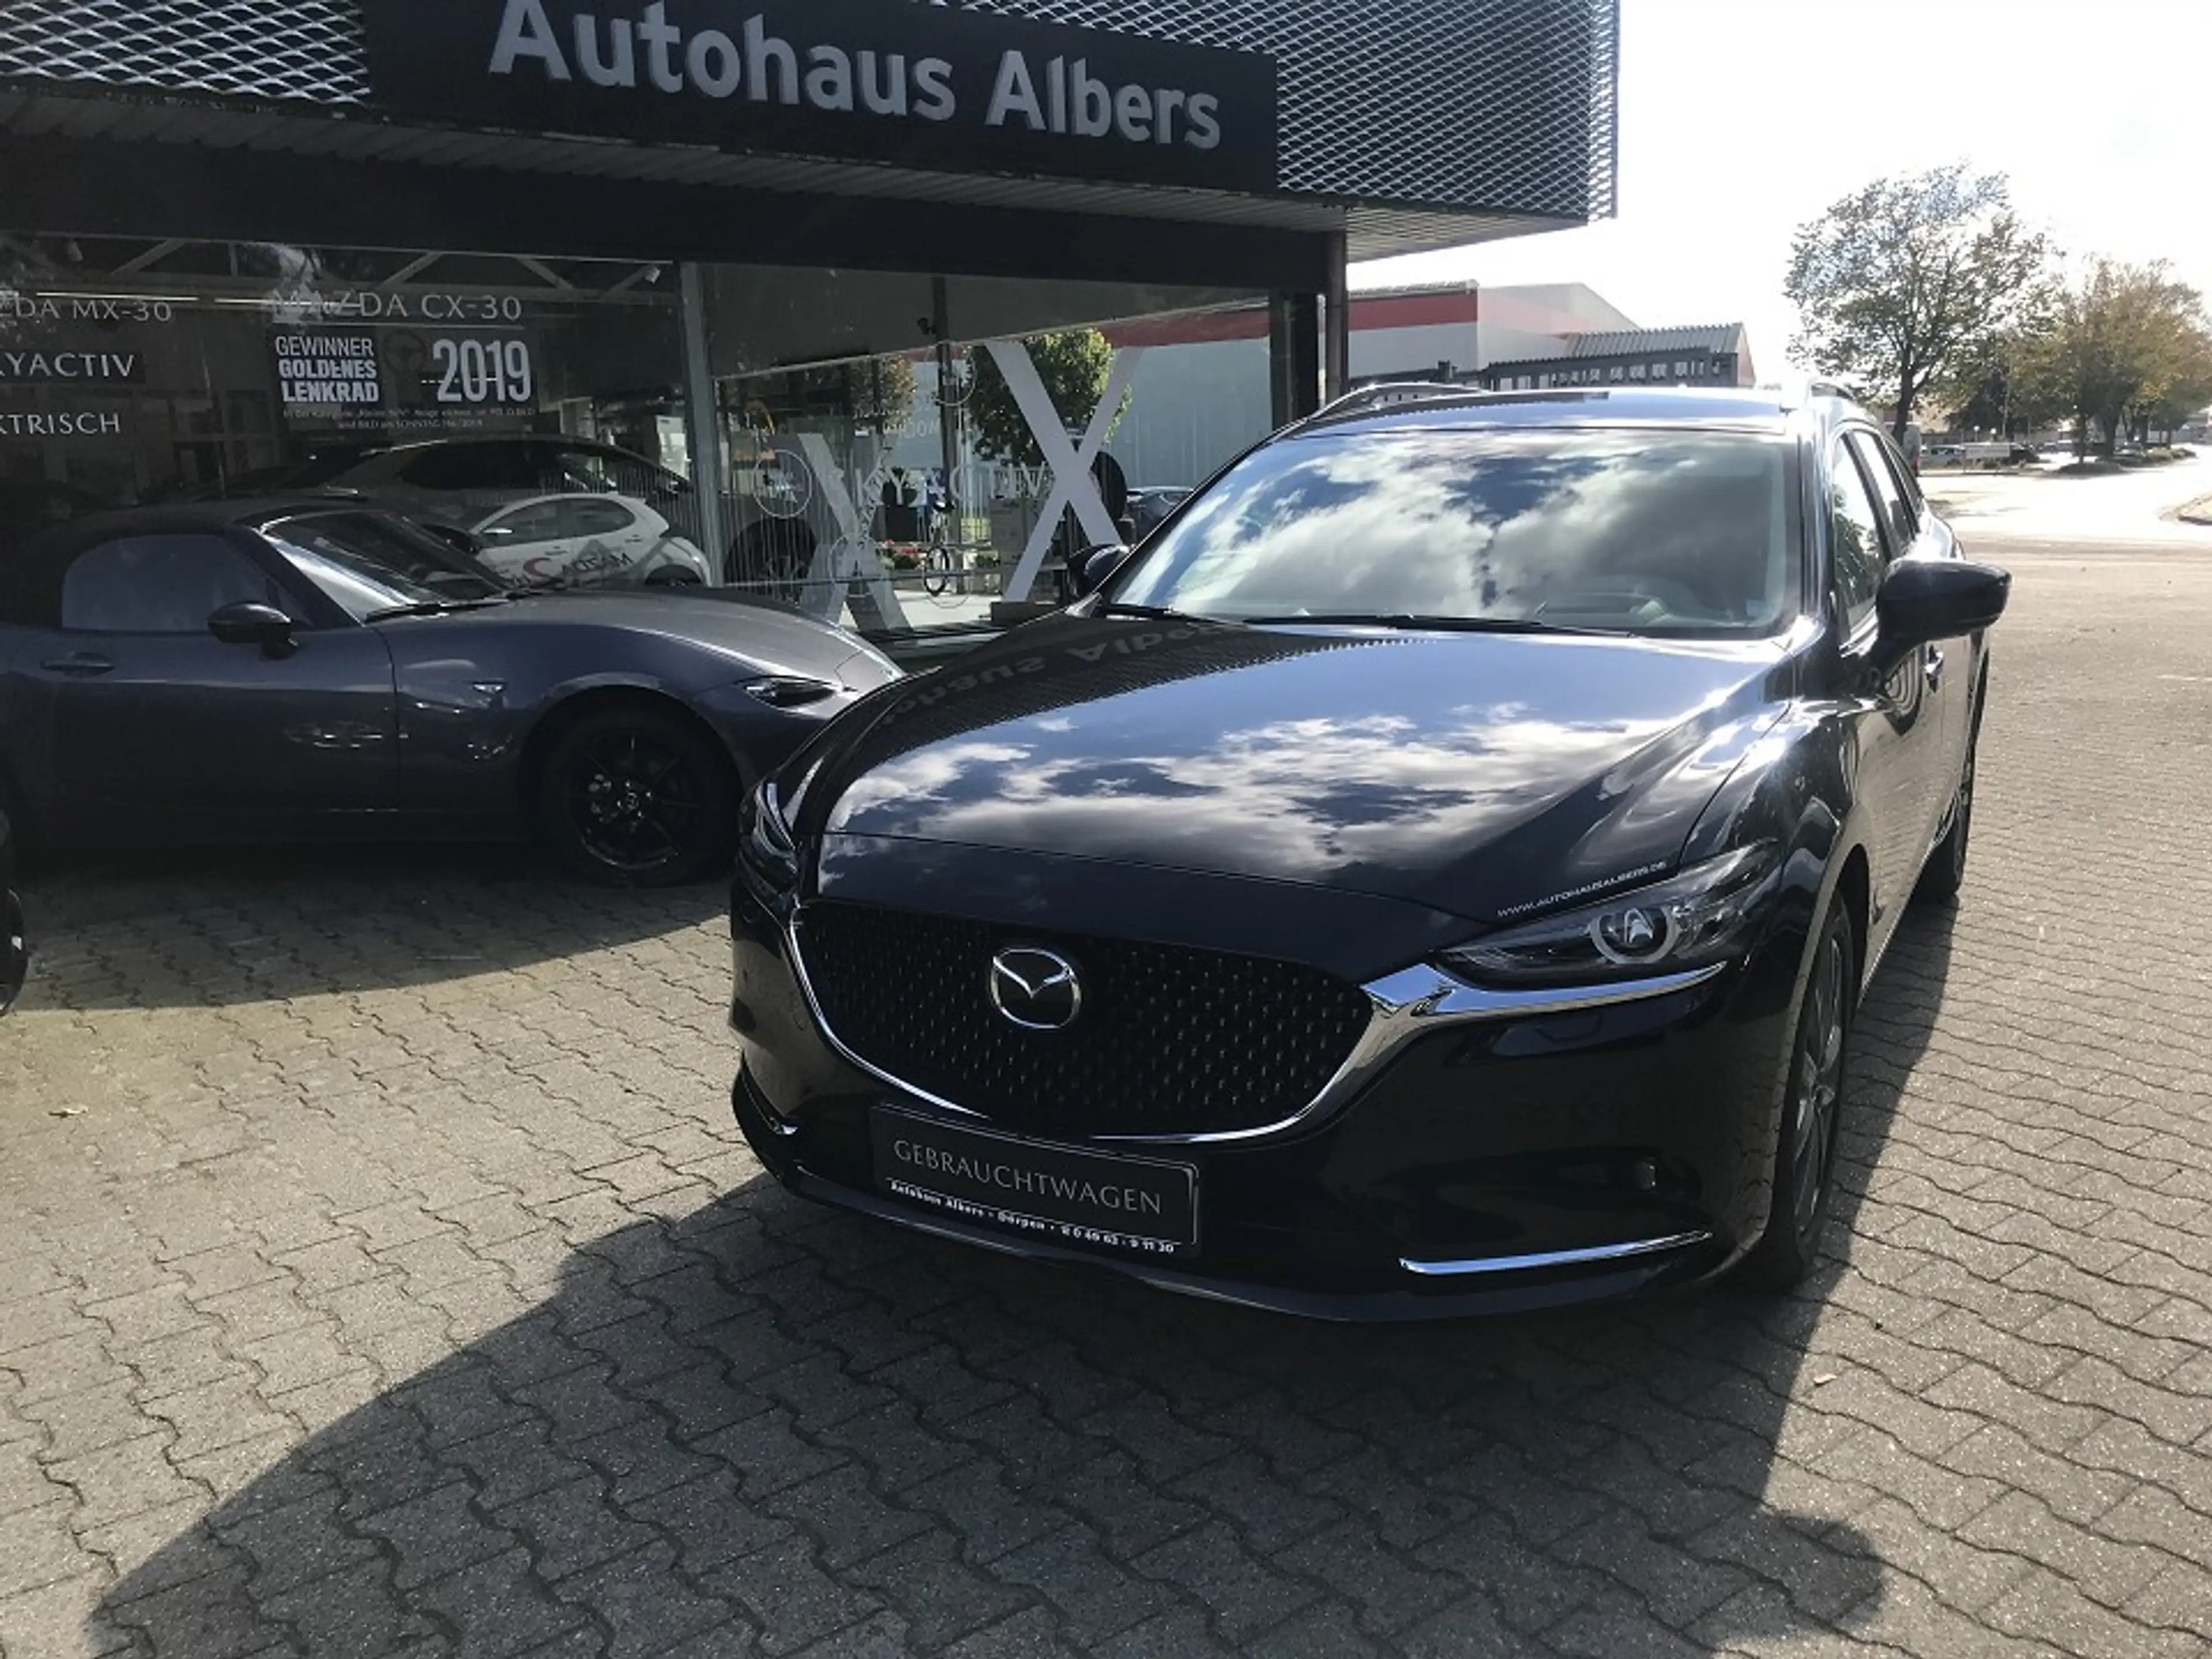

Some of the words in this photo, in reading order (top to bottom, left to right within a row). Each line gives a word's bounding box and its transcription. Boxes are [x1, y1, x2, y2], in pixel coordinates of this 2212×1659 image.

[488, 0, 957, 122] Autohaus
[984, 48, 1222, 150] Albers
[73, 299, 172, 322] MX-30
[421, 293, 522, 321] CX-30
[275, 335, 375, 357] GEWINNER
[0, 351, 136, 378] YACTIV
[278, 358, 378, 380] GOLDENES
[432, 338, 533, 403] 2019
[282, 379, 380, 403] LENKRAD
[893, 1139, 1162, 1215] GEBRAUCHTWAGEN
[946, 1198, 984, 1217] Albers
